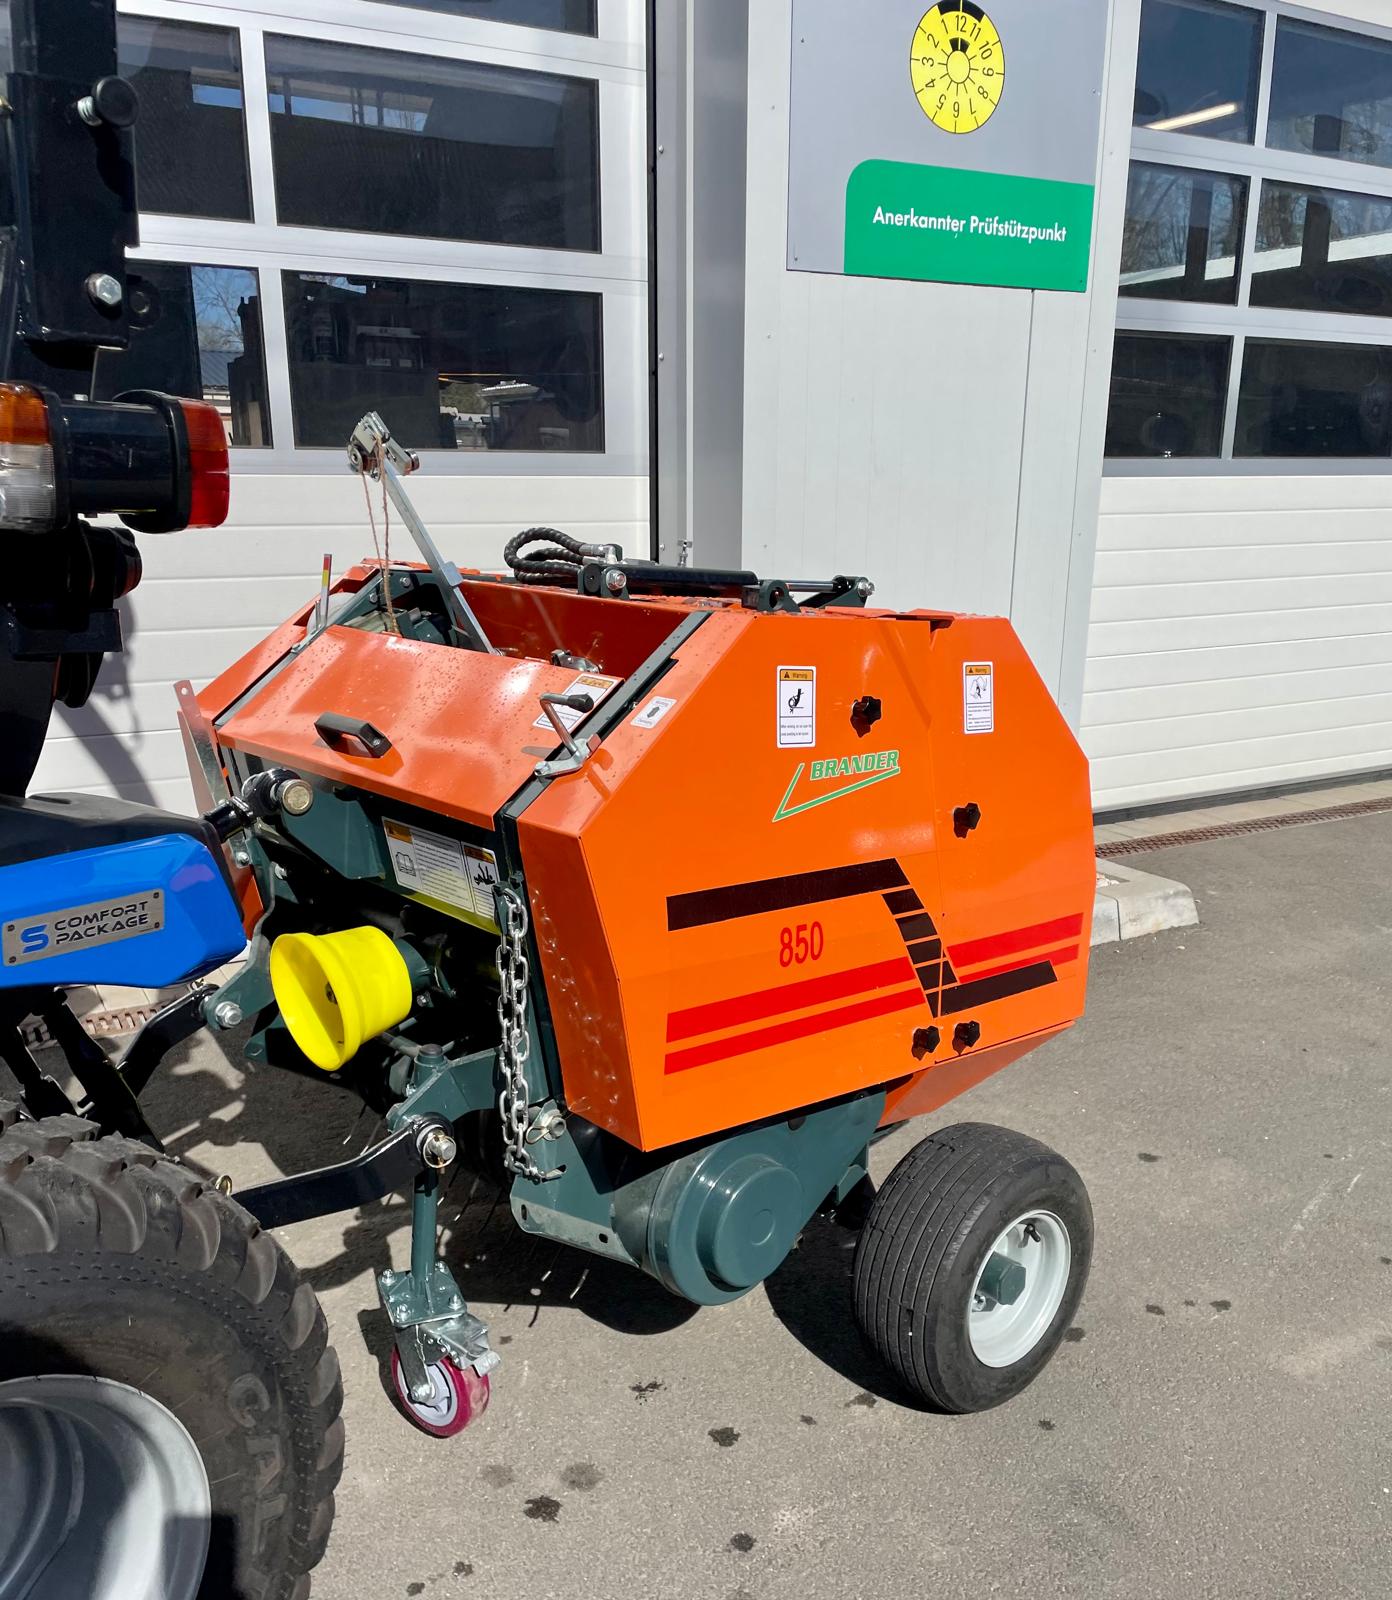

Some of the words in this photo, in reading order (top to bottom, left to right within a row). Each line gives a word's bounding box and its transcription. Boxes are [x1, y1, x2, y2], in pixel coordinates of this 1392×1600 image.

[941, 19, 949, 35] 1
[955, 14, 967, 33] 12
[969, 22, 982, 42] 11
[926, 33, 940, 49] 2
[978, 40, 993, 61] 10
[921, 56, 935, 67] 3
[982, 67, 995, 77] 9
[925, 78, 936, 88] 4
[935, 93, 947, 110] 5
[977, 85, 989, 100] 8
[952, 101, 960, 119] 6
[969, 97, 977, 115] 7
[872, 205, 966, 233] Anerkannter
[969, 215, 1067, 244] Prüfstützpunkt
[810, 749, 899, 781] BRANDER
[54, 901, 148, 931] COMFORT
[56, 913, 149, 945] PACKAGE
[20, 924, 49, 954] S
[779, 921, 824, 967] 850
